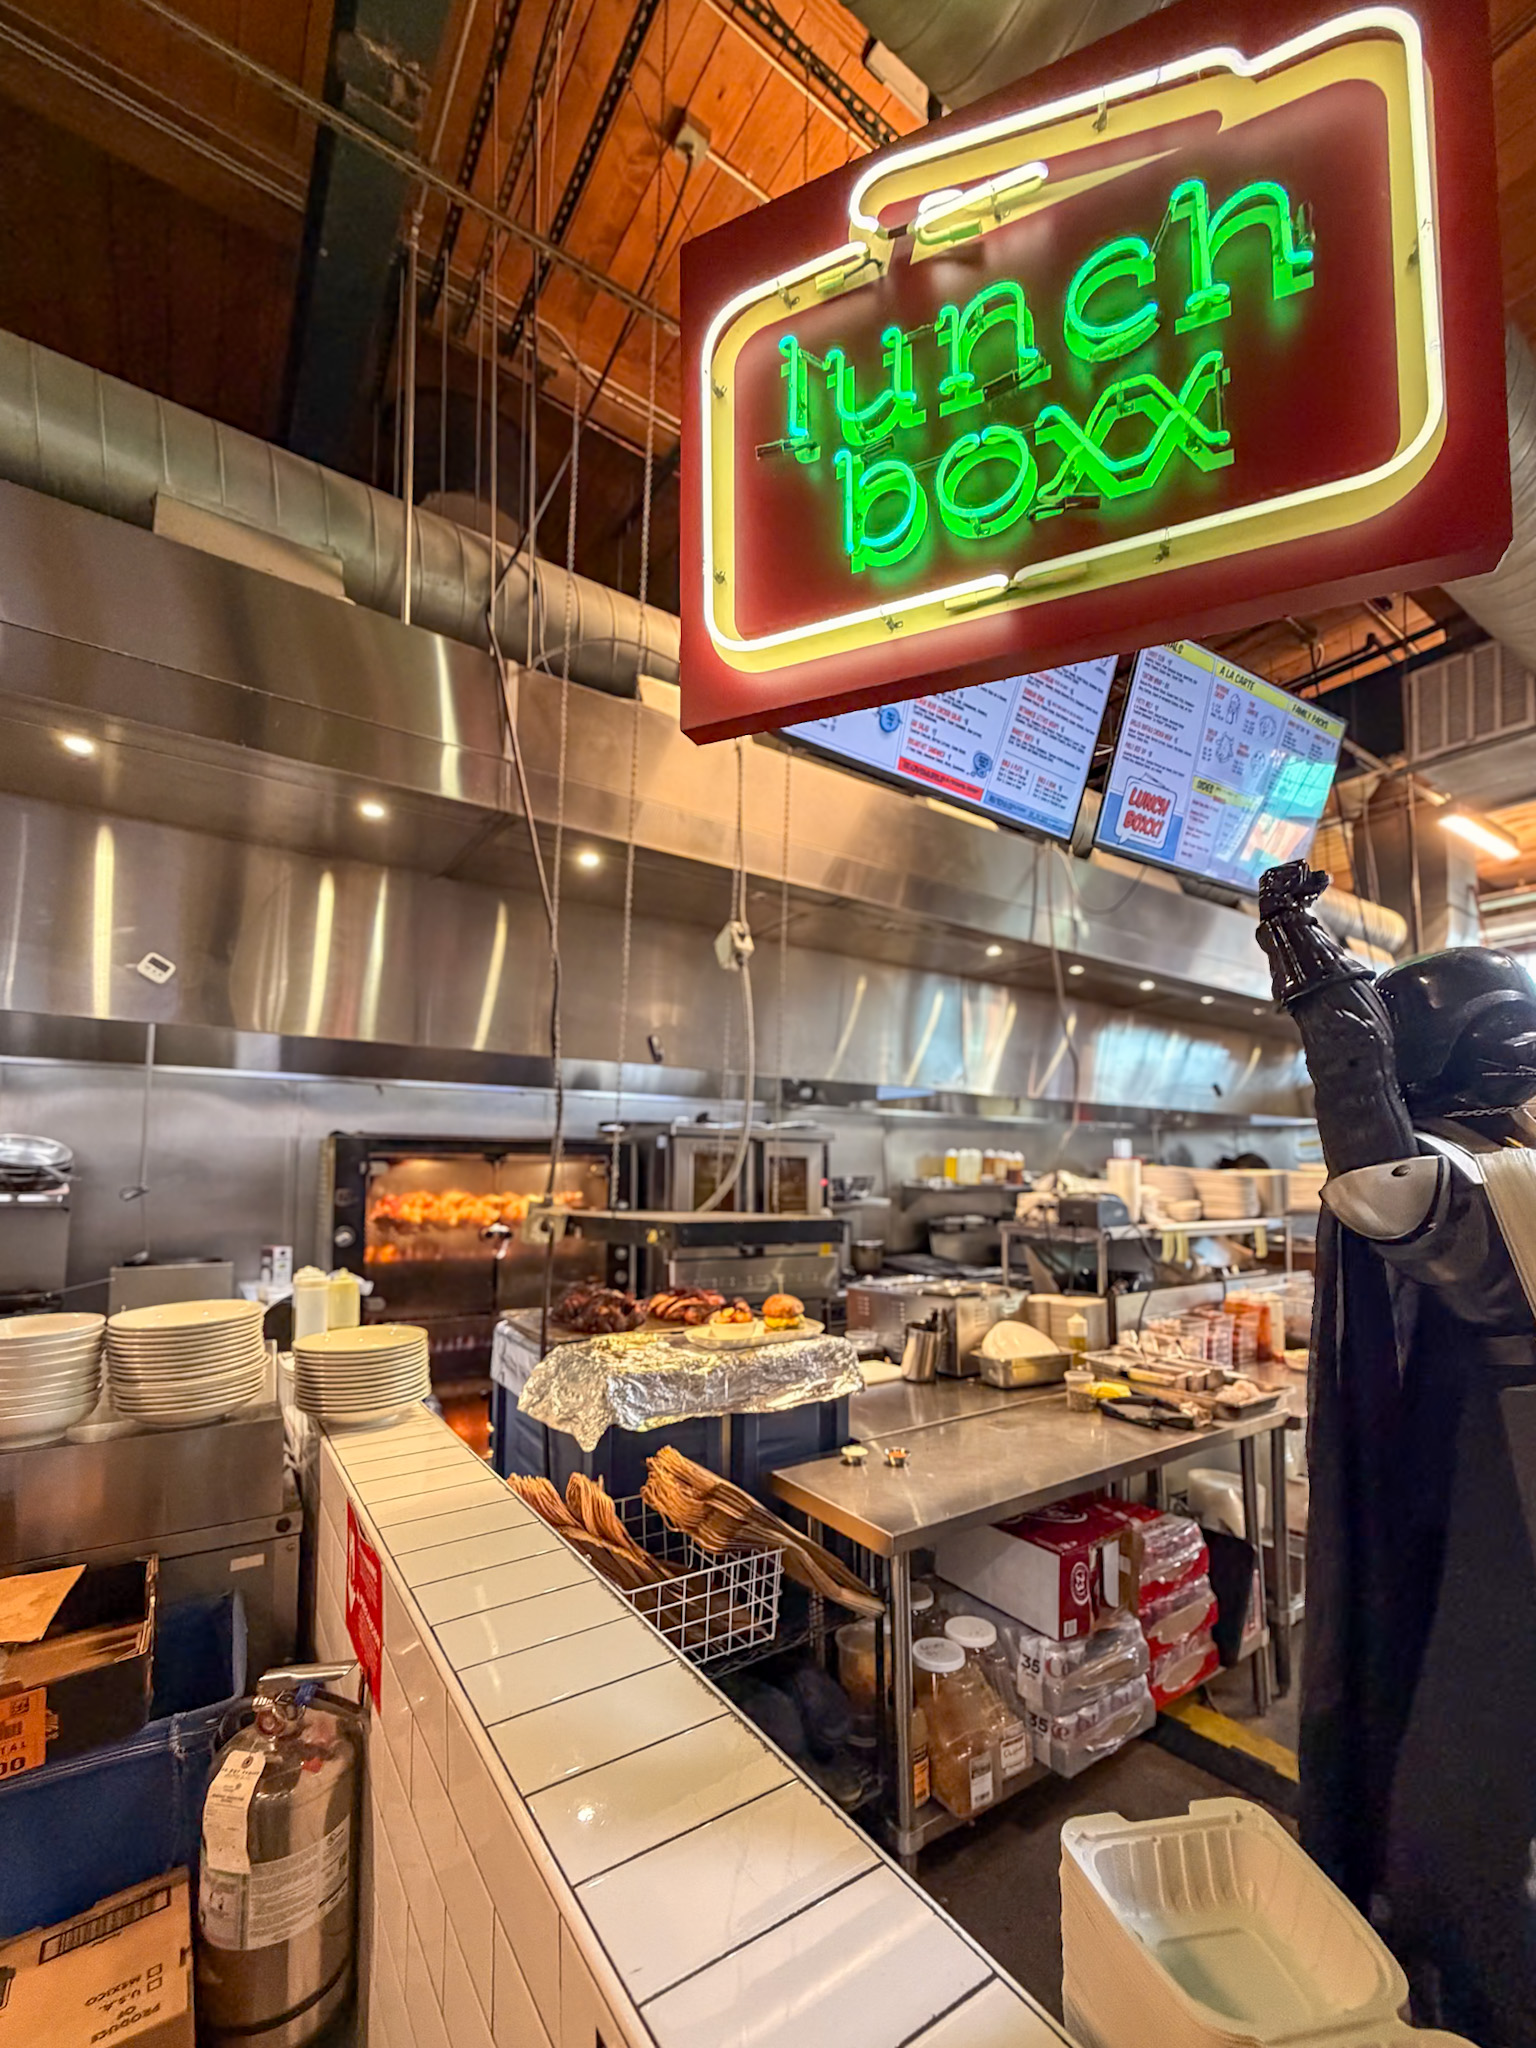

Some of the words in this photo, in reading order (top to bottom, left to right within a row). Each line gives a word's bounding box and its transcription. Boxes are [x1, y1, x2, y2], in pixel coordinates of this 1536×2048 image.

[779, 178, 1314, 465] lunch
[834, 351, 1235, 574] boxx
[1219, 666, 1226, 675] A
[1226, 668, 1234, 681] LA
[1234, 674, 1256, 691] CARTE
[1291, 703, 1312, 721] FAMILY
[1312, 714, 1329, 730] PACKS
[1128, 786, 1171, 817] LUNCH
[1020, 1653, 1041, 1675] 35
[1028, 1711, 1048, 1733] 35
[84, 1974, 142, 2007] MEXICO
[98, 1989, 141, 2012] U.S.A.
[90, 2002, 160, 2044] PRODUCE
[117, 2006, 136, 2020] OF
